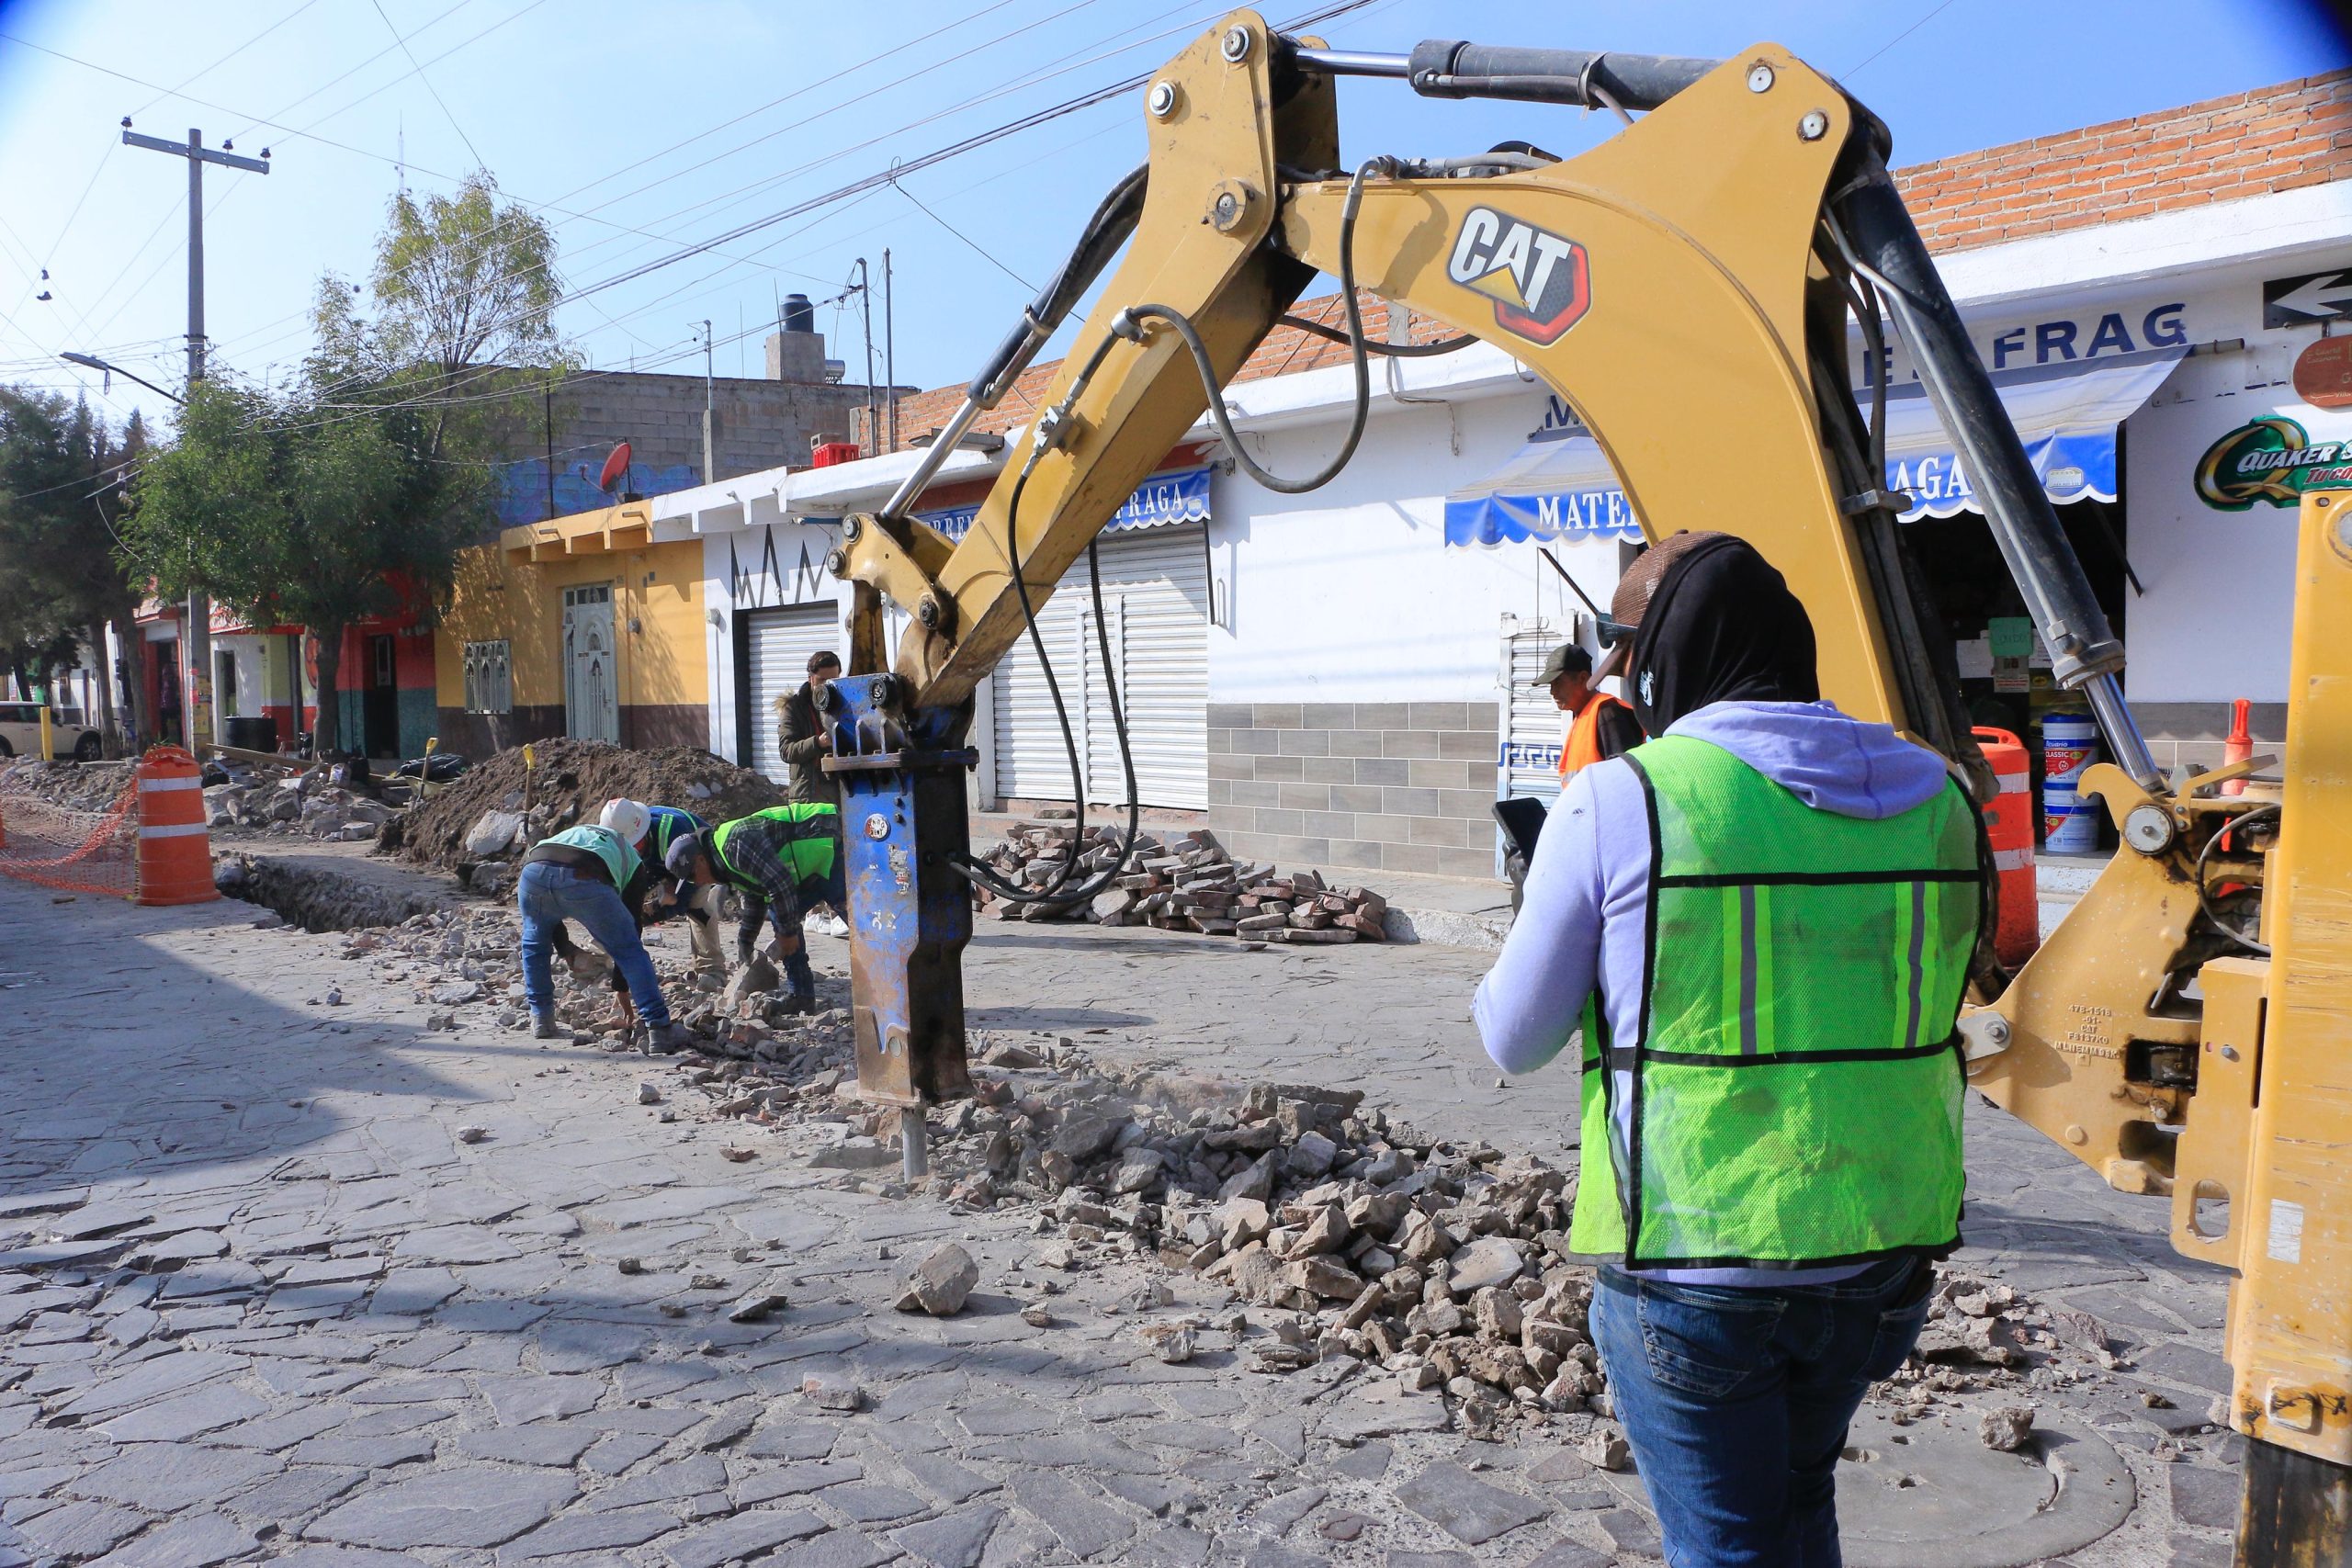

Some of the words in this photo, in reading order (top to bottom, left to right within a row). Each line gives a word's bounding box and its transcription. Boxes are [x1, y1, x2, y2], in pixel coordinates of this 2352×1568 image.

[1450, 209, 1572, 313] CAT
[1994, 303, 2188, 369] FRAG
[2236, 446, 2338, 474] QUAKER
[1536, 491, 1639, 532] MATE
